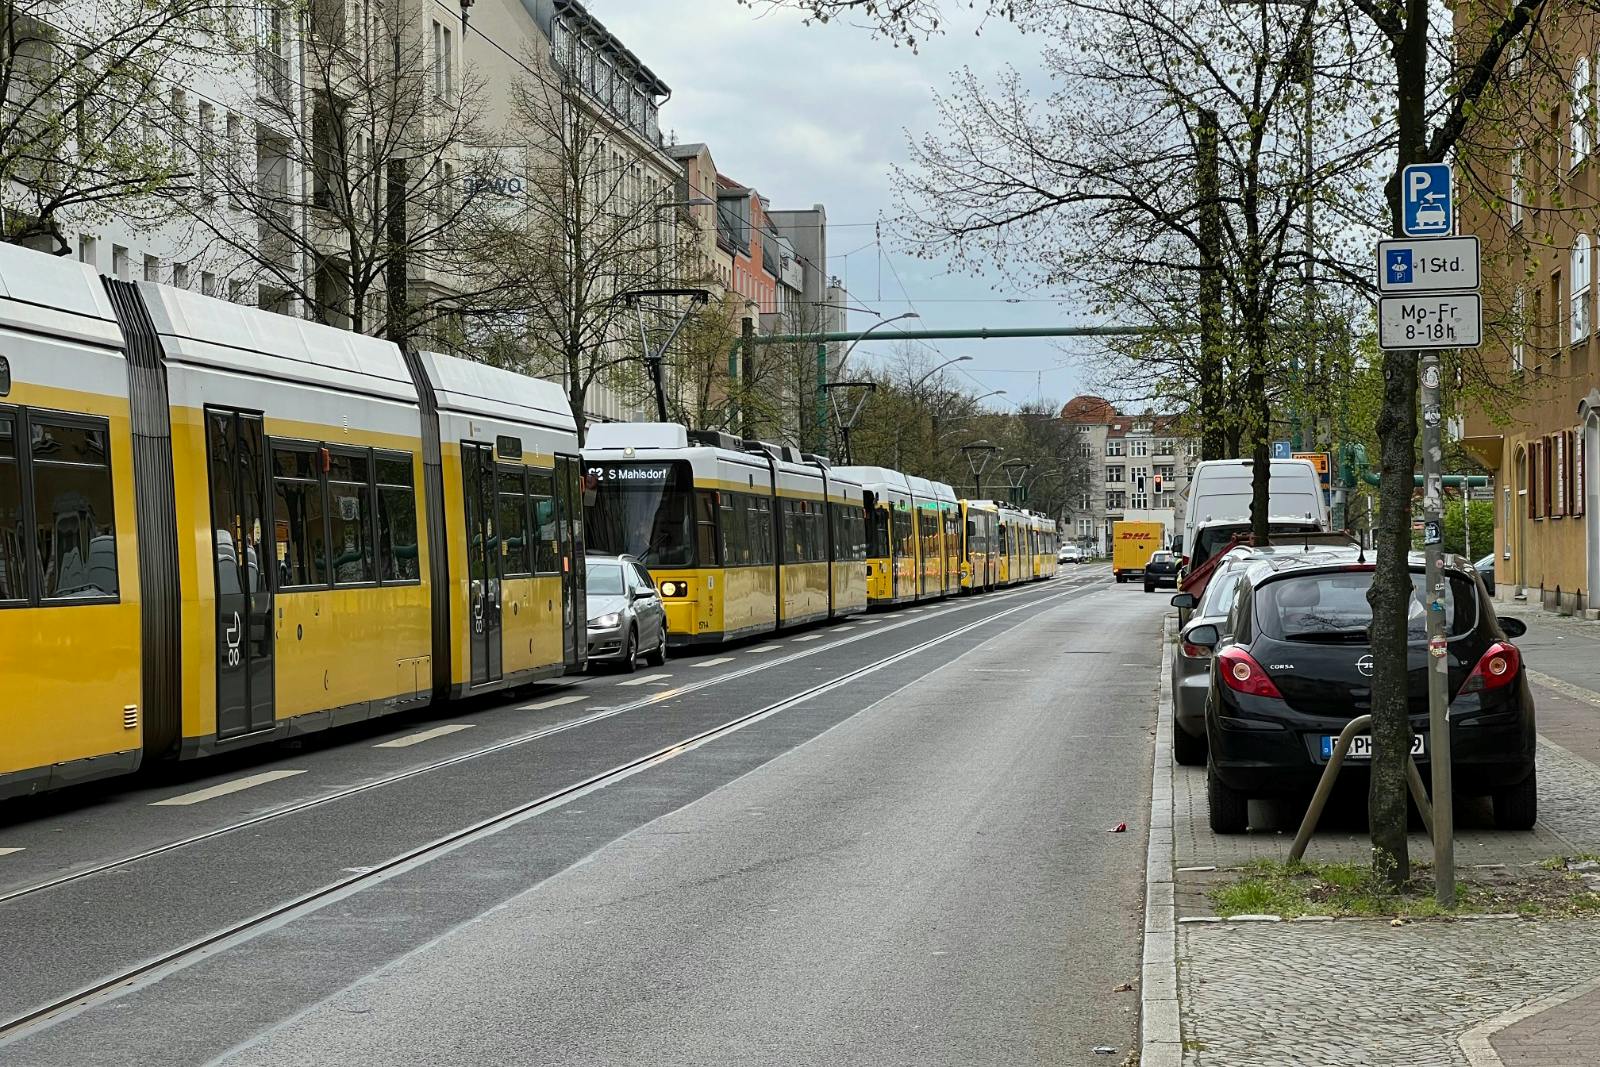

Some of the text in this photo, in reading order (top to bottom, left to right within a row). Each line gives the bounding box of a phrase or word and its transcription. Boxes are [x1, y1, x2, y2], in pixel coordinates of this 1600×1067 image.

[1410, 171, 1431, 202] P
[1420, 256, 1465, 274] 1 Std.
[1401, 303, 1458, 320] Mo-Fr
[1405, 323, 1455, 340] 8-18h
[1275, 443, 1284, 457] P
[608, 469, 617, 480] S
[618, 468, 667, 480] Mahlsdorf
[1122, 532, 1151, 540] DHL
